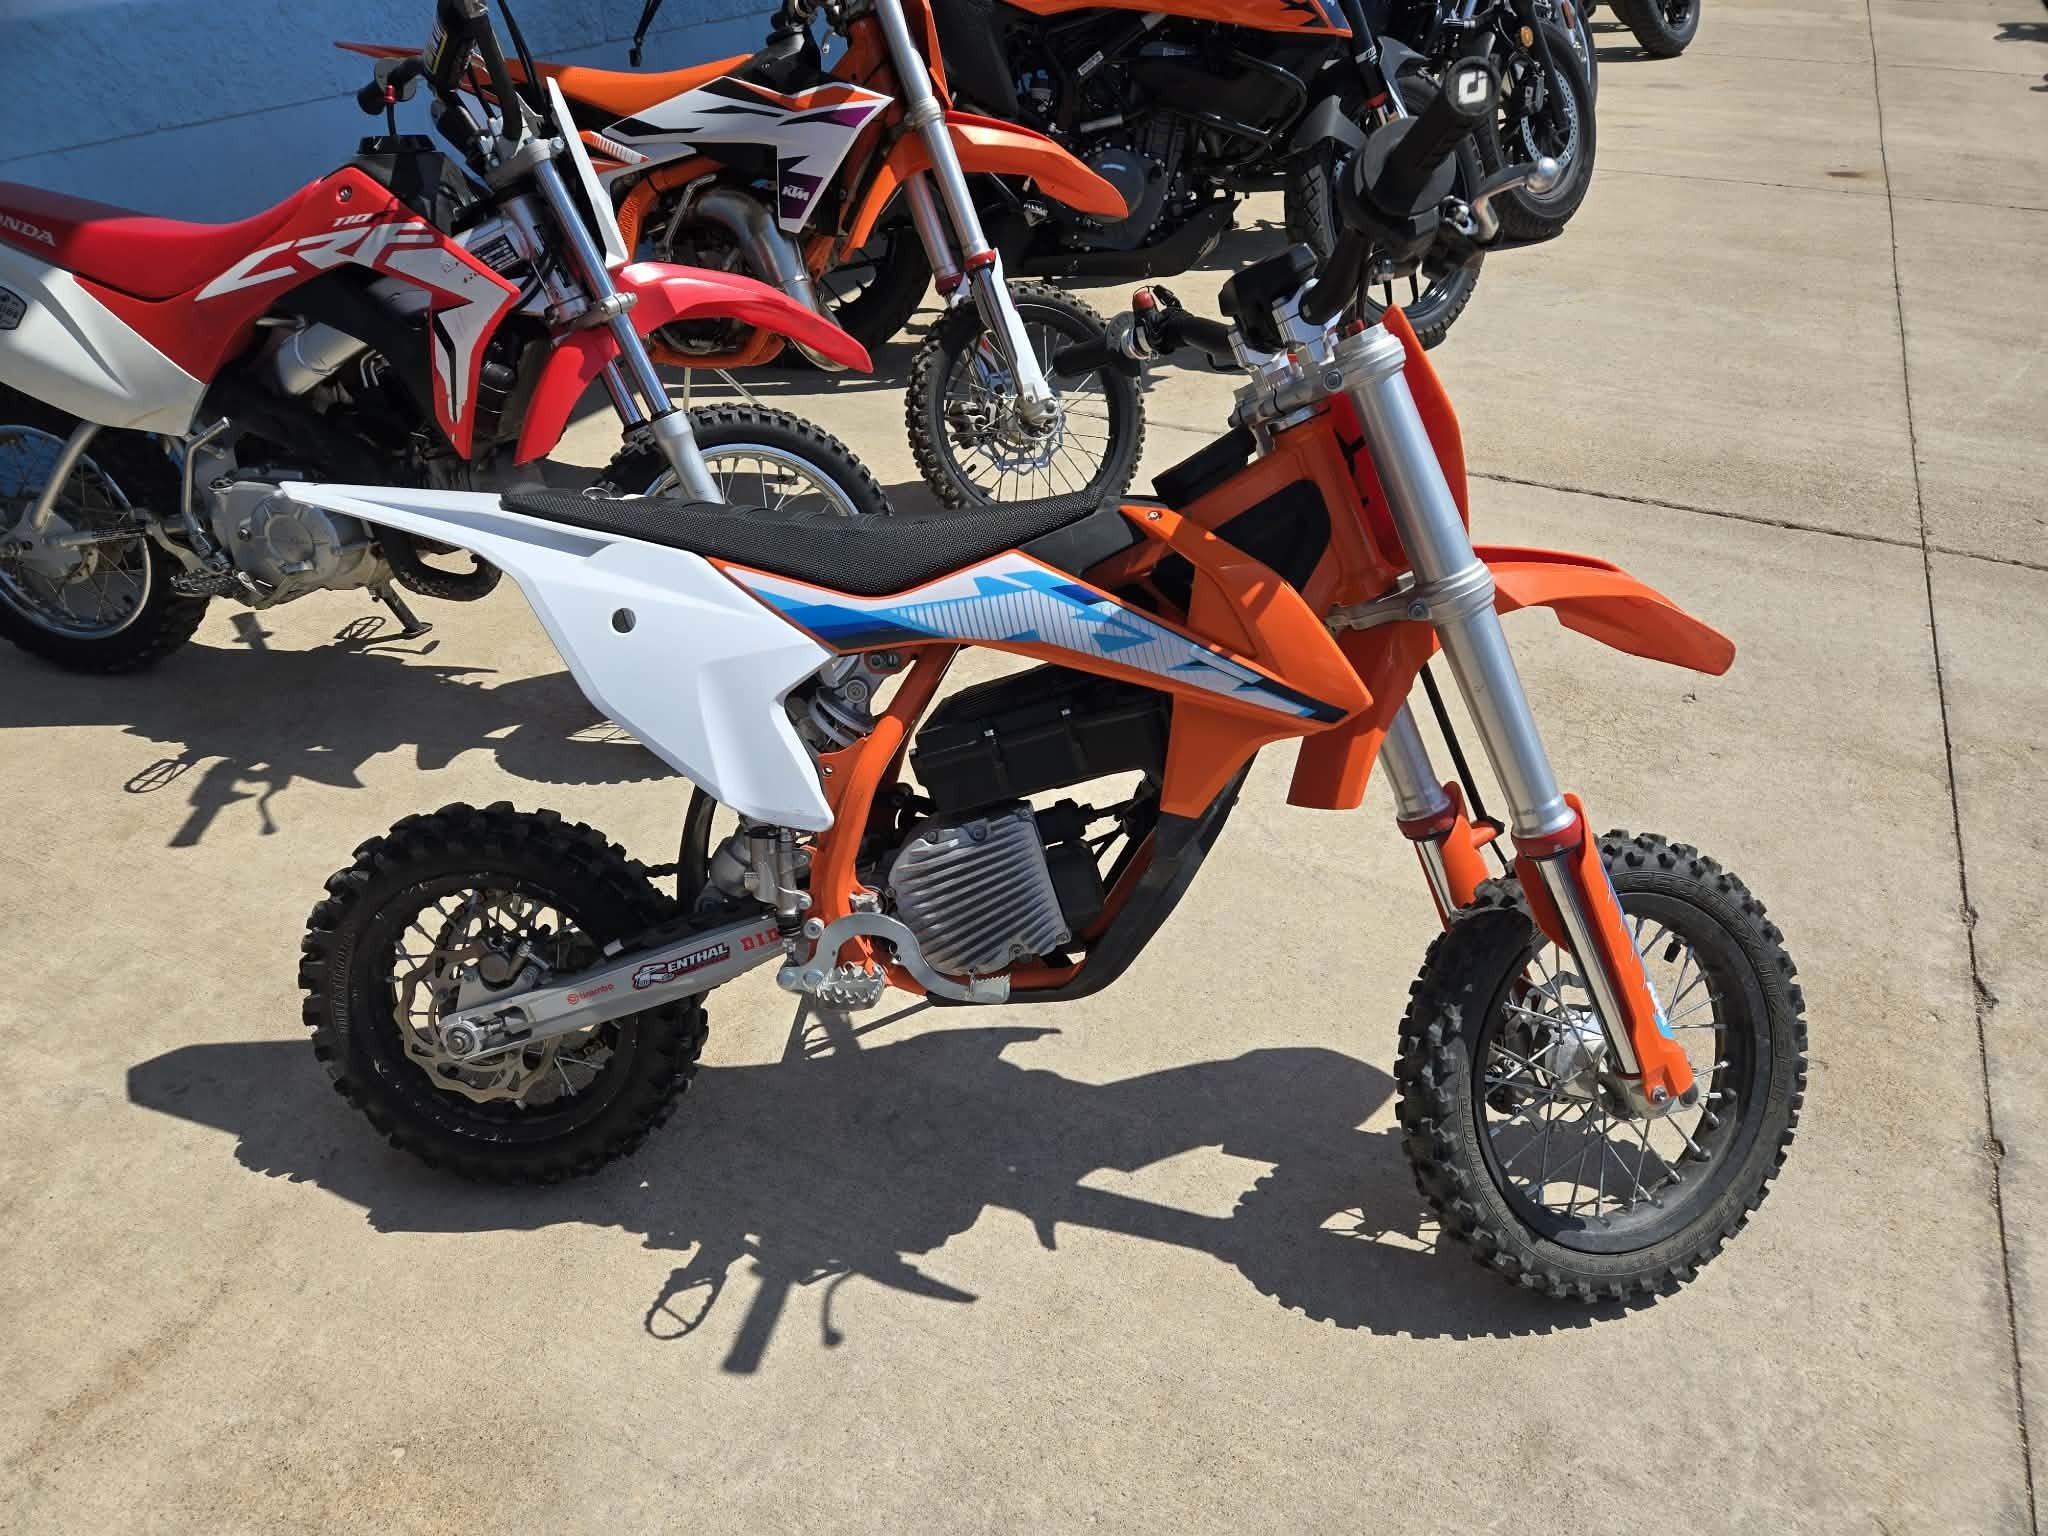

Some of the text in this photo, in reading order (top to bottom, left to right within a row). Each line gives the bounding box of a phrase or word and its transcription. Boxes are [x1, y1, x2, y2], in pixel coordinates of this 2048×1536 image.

[332, 212, 374, 227] 110
[194, 220, 436, 303] CRF
[634, 943, 729, 989] RENTHAL
